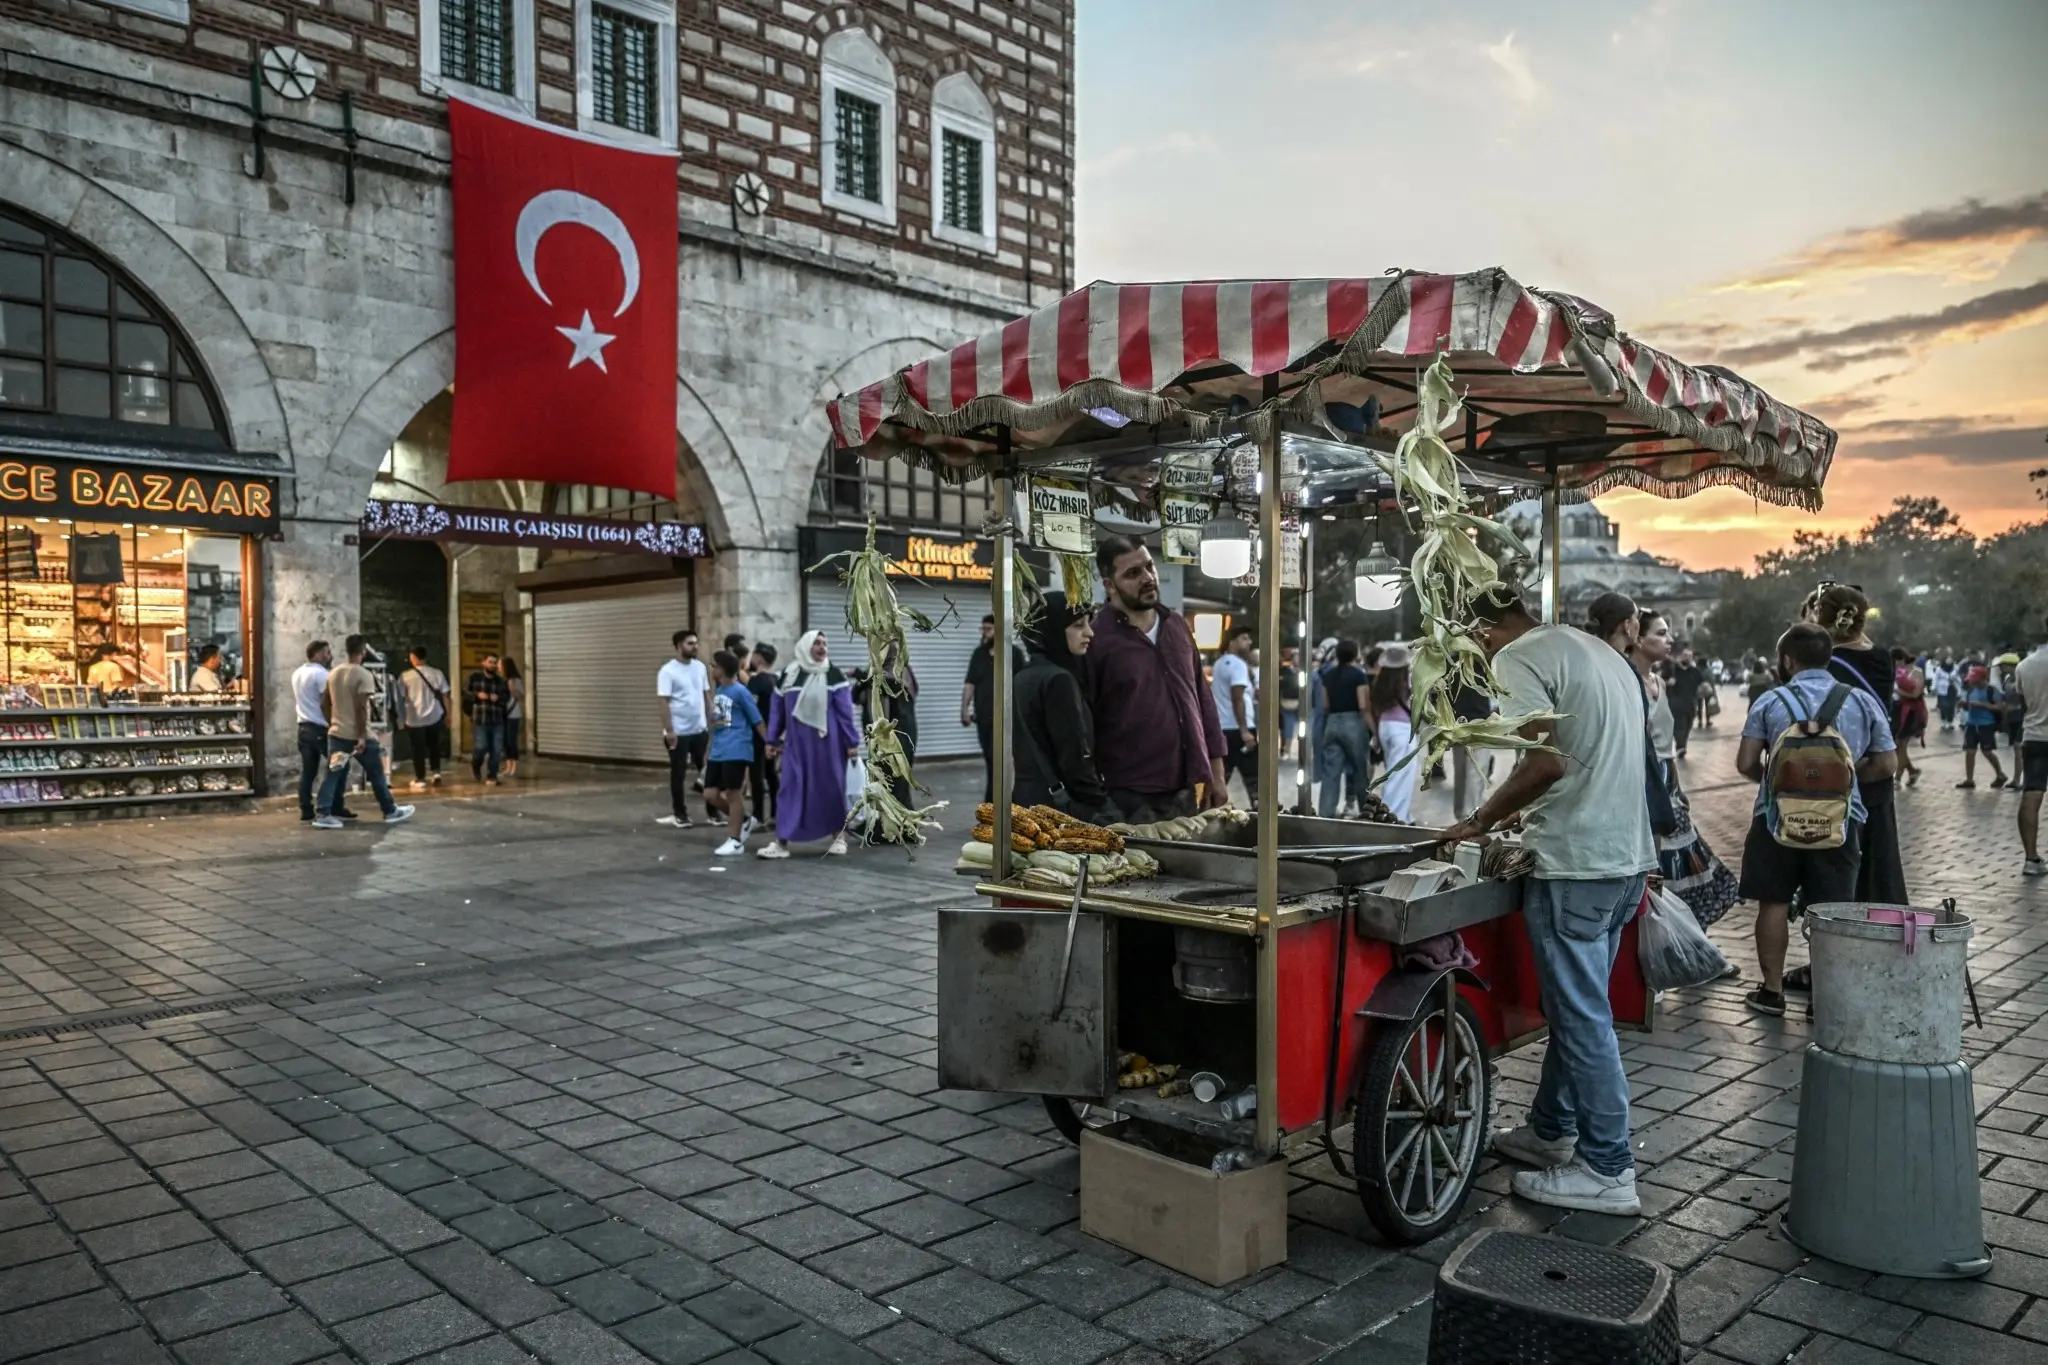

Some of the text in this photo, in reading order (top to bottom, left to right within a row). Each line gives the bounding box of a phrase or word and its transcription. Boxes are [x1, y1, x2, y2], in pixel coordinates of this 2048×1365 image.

[72, 469, 271, 518] BAZAAR
[1033, 489, 1089, 517] KÖZ MISIR
[1165, 502, 1209, 524] SÜT MISIR
[456, 514, 631, 545] MISIR ÇARŞISI (1664)
[1051, 522, 1064, 533] 40
